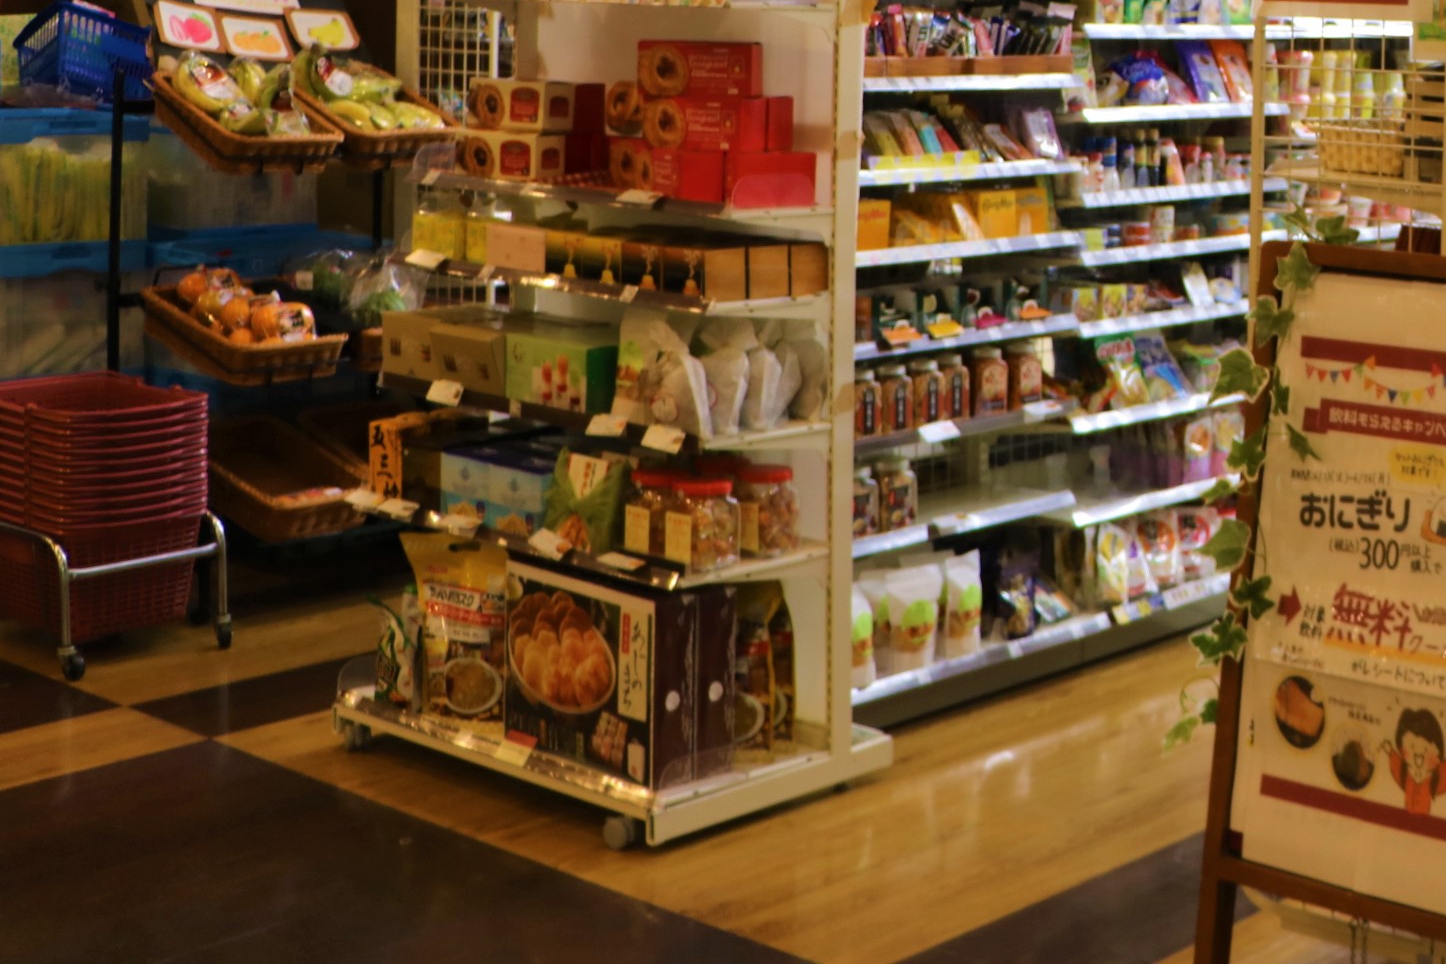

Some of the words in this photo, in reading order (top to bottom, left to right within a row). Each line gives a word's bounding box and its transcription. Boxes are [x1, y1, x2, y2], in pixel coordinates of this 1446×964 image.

[1300, 489, 1411, 533] おにぎり
[1359, 536, 1400, 570] 300
